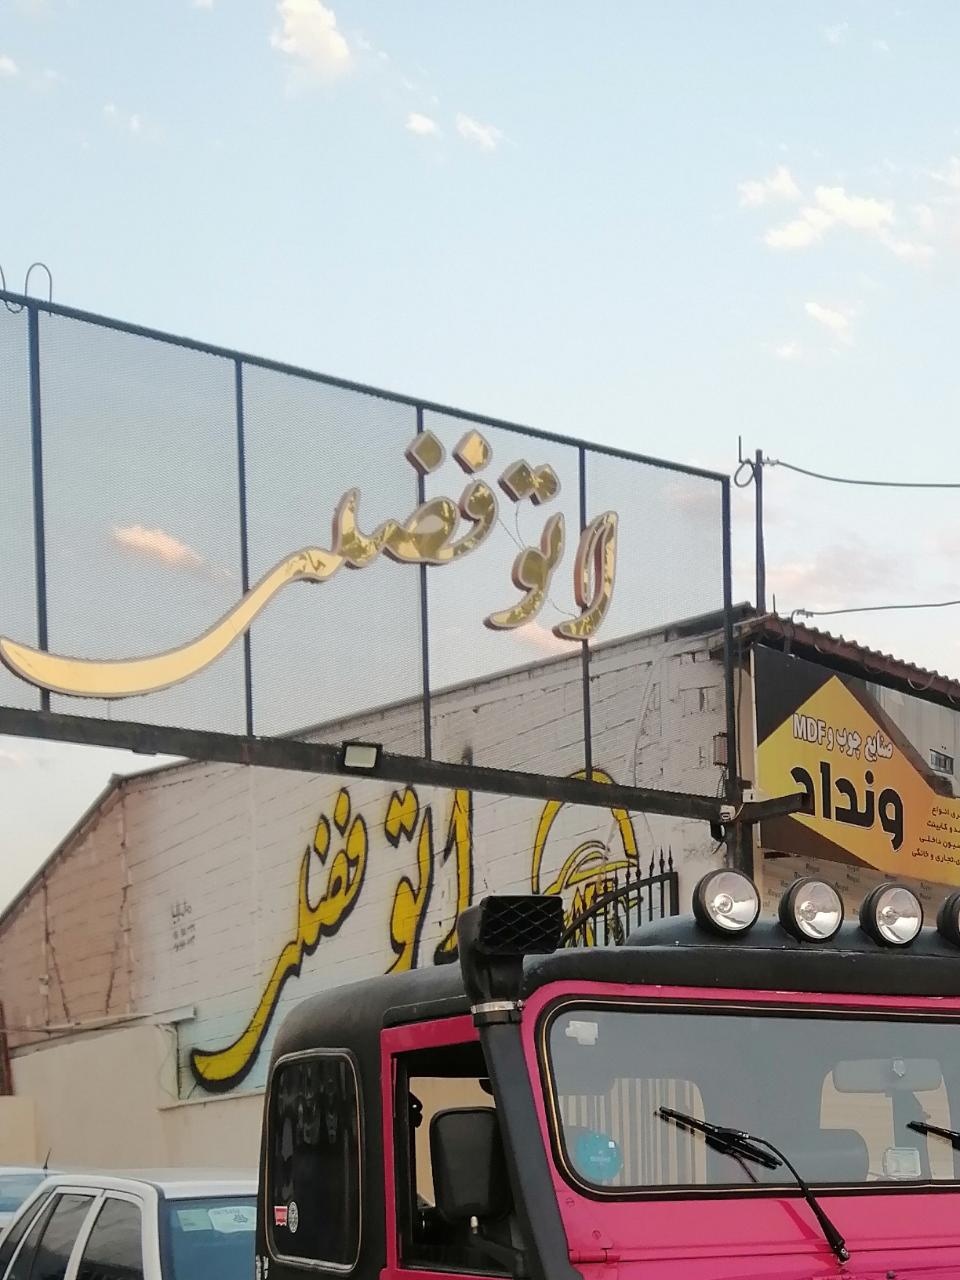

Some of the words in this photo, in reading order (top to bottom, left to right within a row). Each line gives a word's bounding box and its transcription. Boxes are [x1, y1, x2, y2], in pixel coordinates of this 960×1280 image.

[793, 713, 826, 745] MDF
[826, 727, 834, 752] و
[836, 728, 861, 760] چوب
[864, 730, 893, 762] صنایع
[790, 761, 904, 850] ونداد
